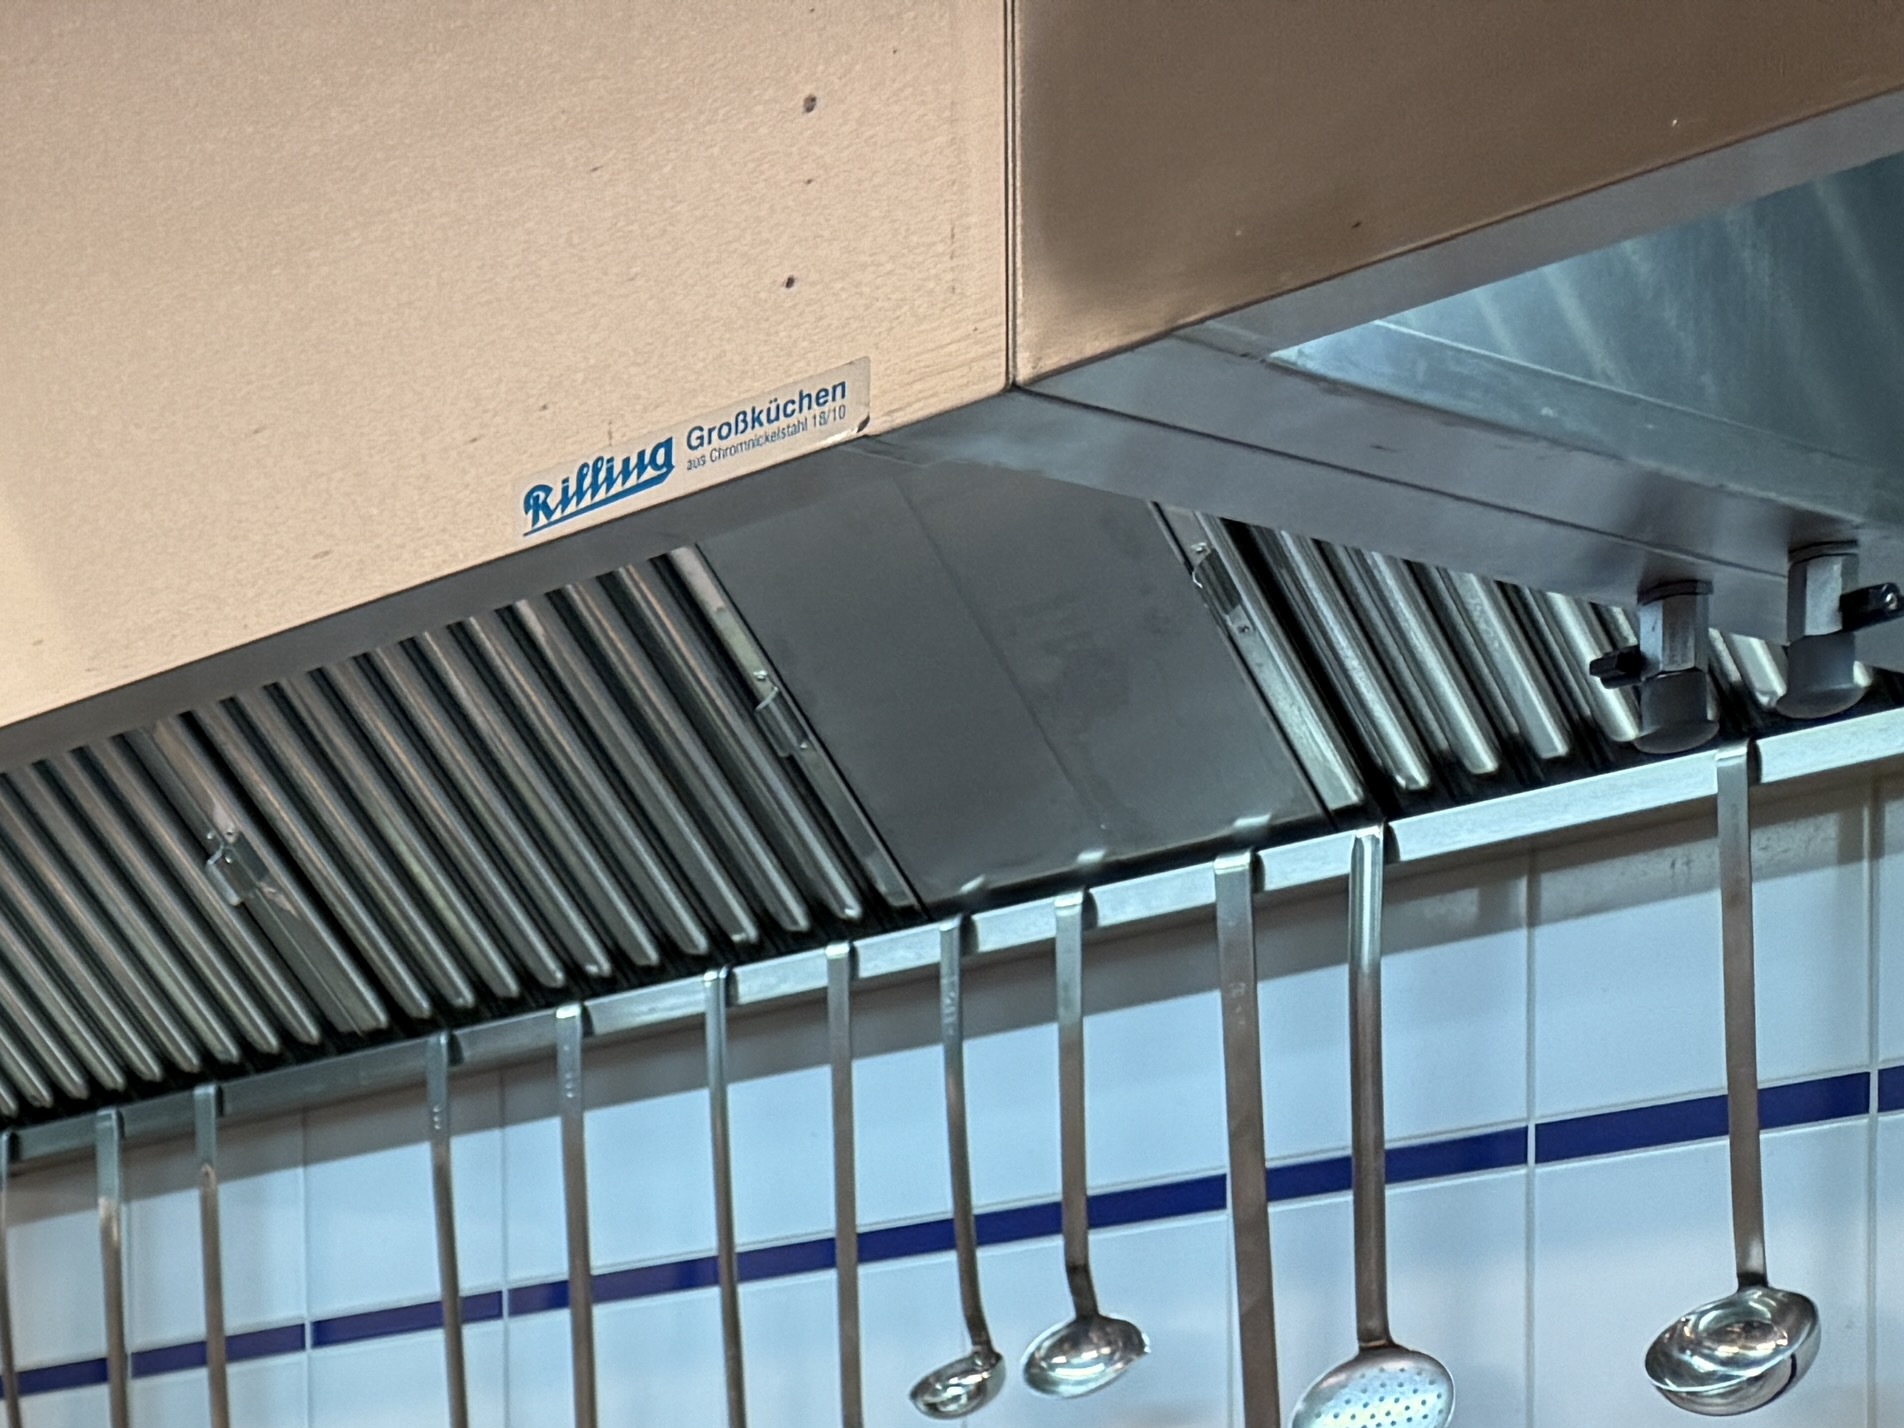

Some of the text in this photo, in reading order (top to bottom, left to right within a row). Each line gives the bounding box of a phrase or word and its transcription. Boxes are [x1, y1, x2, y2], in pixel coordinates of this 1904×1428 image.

[686, 380, 847, 451] Großküchen
[709, 417, 809, 464] Chromnickelstahl
[811, 404, 847, 430] 18/10
[523, 436, 675, 532] Rilling
